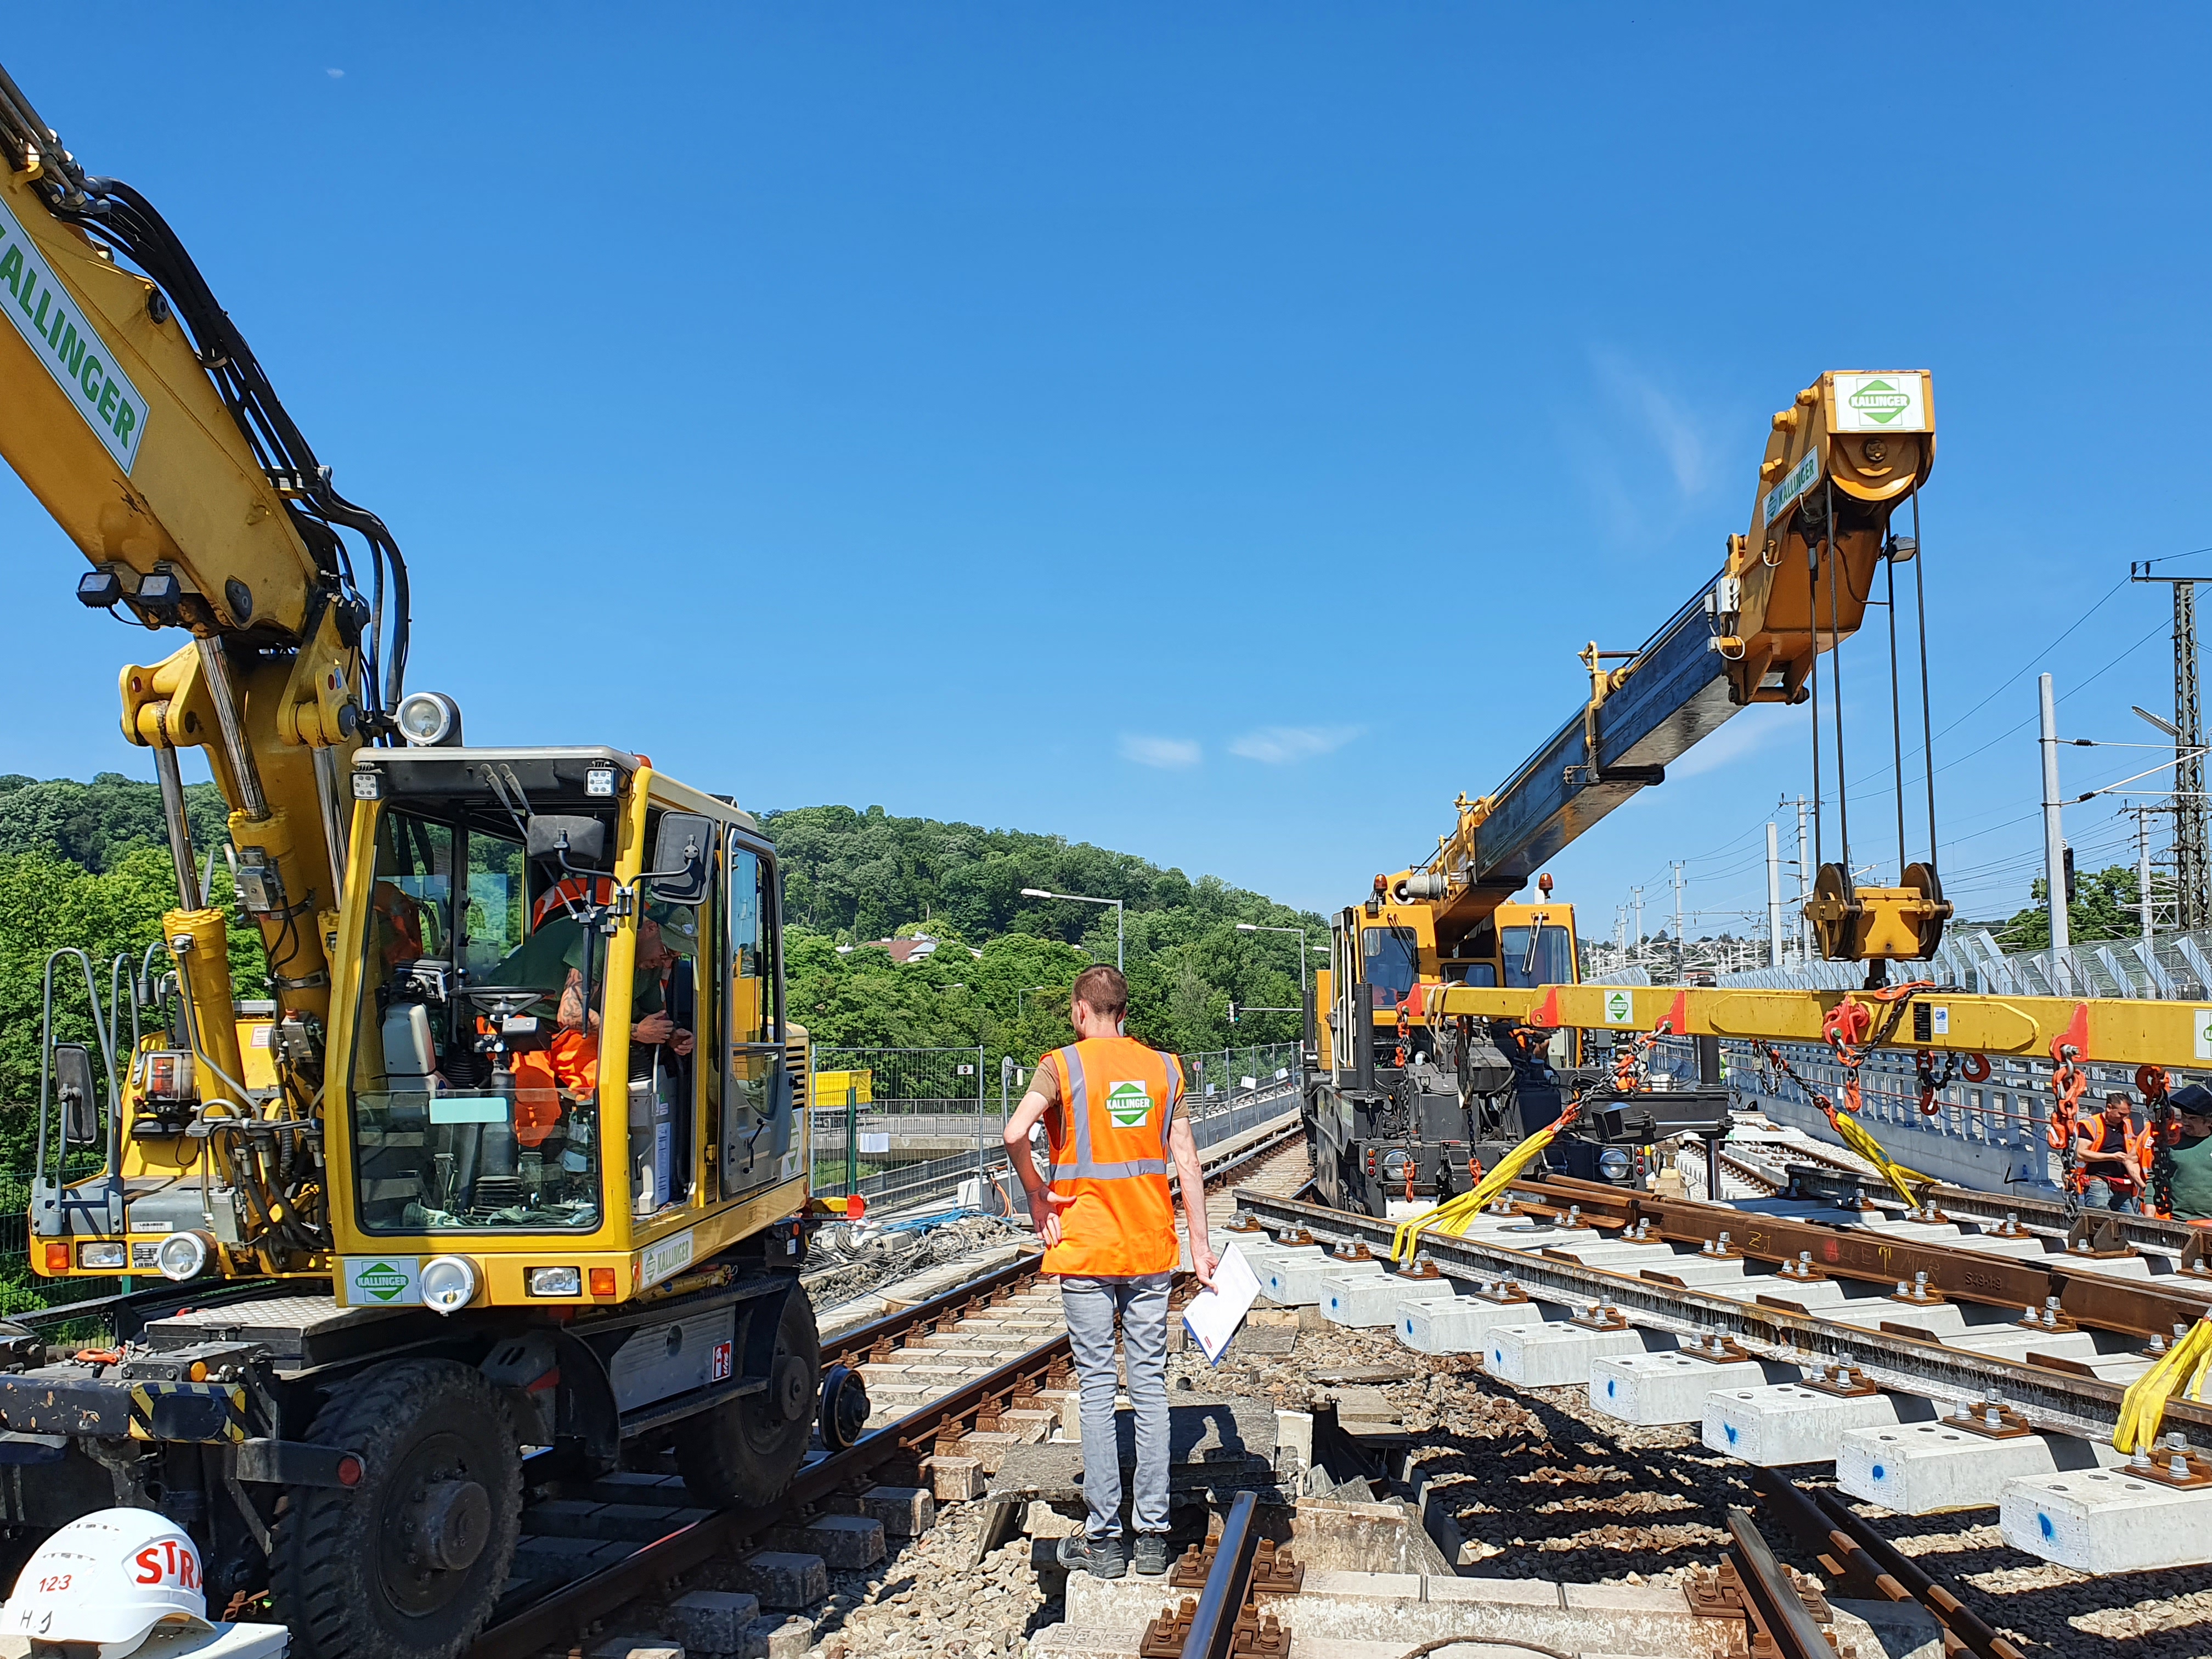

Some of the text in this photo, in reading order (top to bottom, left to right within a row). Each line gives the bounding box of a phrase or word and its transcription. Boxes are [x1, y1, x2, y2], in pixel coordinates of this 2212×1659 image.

[0, 224, 136, 450] ALLINGER
[1850, 395, 1908, 407] KALLINGER
[1779, 459, 1814, 507] KALLINGER
[1106, 1098, 1150, 1109] KALLINGER
[657, 1240, 689, 1274] KALLINGER
[357, 1277, 407, 1286] KALLINGER
